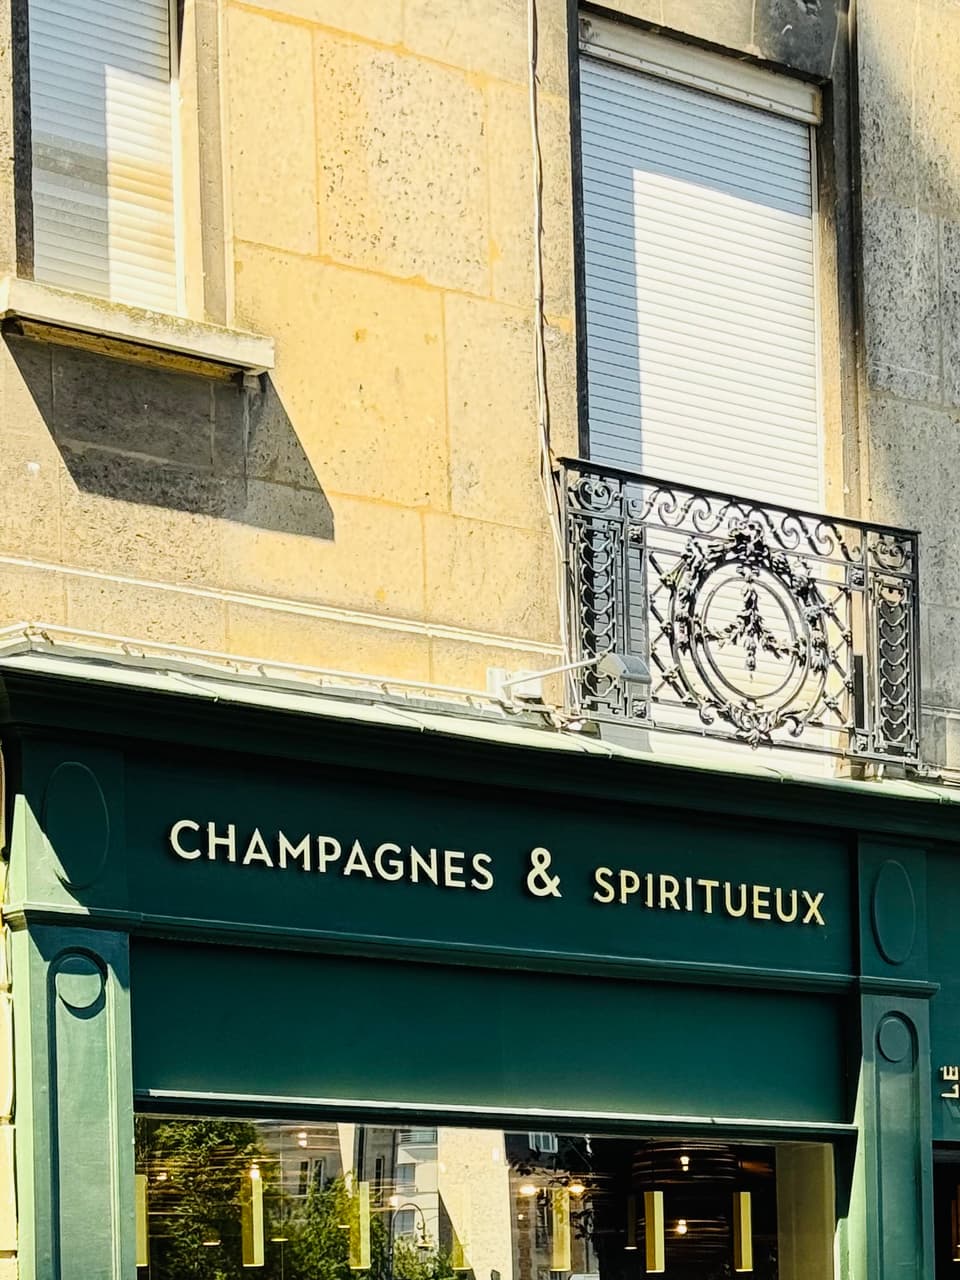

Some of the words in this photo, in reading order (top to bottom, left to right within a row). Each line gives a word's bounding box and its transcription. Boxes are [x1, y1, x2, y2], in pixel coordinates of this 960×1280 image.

[170, 819, 494, 890] CHAMPAGNES
[526, 847, 562, 898] &
[593, 867, 825, 926] SPIRITUEUX
[940, 1065, 960, 1099] LE
